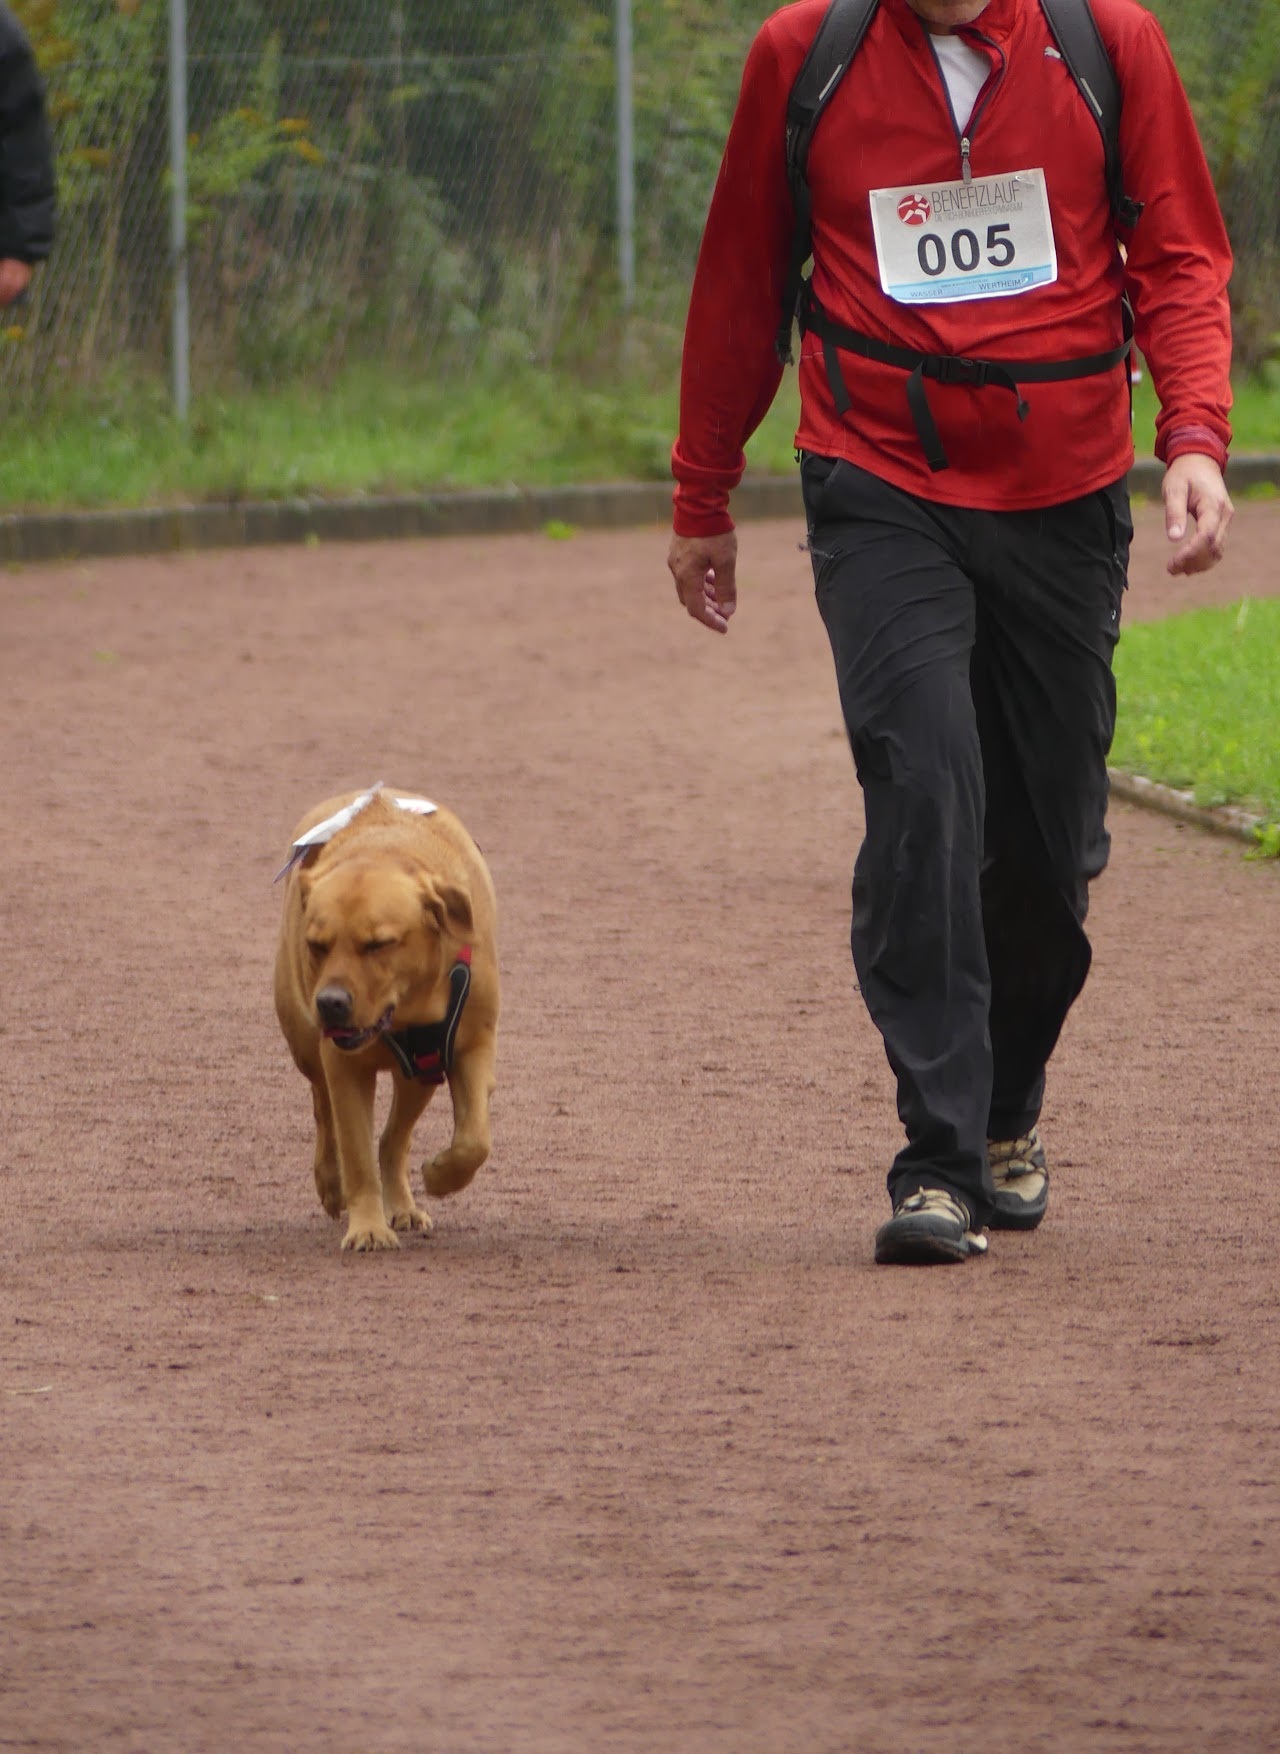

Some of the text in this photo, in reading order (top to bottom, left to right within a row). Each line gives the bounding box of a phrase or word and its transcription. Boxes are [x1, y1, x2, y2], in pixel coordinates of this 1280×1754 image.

[931, 179, 1020, 213] BENEFIZLAUF
[917, 223, 1015, 276] 005
[910, 288, 943, 298] WASSER
[979, 279, 1021, 290] WERTHEIM
